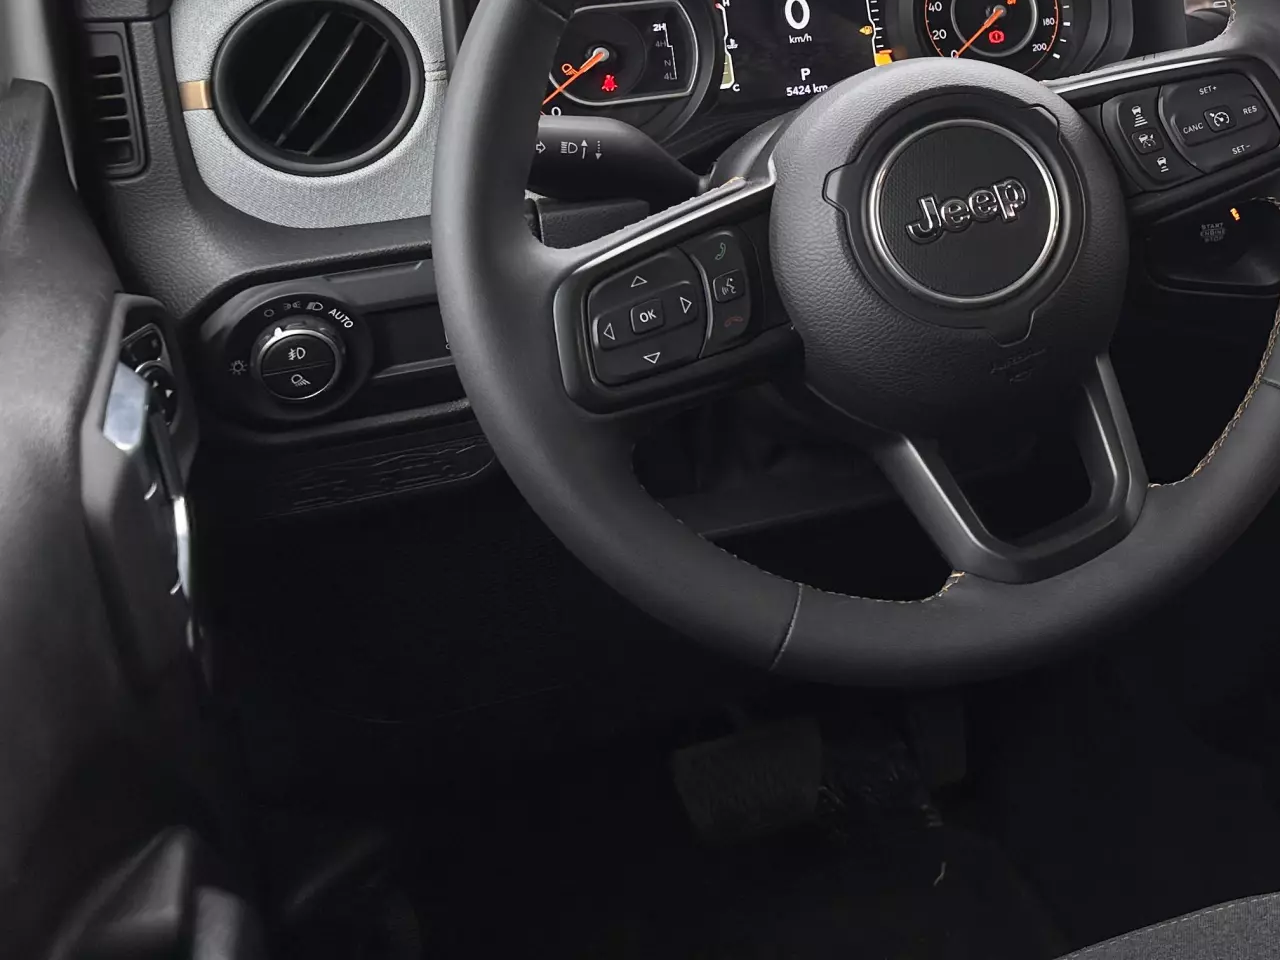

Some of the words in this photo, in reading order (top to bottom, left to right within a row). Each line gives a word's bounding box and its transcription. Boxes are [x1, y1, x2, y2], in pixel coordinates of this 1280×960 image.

[722, 0, 731, 7] H
[928, 1, 943, 12] 40
[1042, 17, 1055, 26] 180
[653, 23, 666, 32] 2H
[789, 33, 813, 44] km/h
[932, 29, 947, 40] 20
[1032, 42, 1047, 52] 200
[800, 68, 811, 81] P
[732, 84, 740, 92] C
[786, 84, 812, 97] 5424
[813, 83, 828, 93] km
[1199, 85, 1217, 96] SET+
[551, 106, 561, 116] 0
[1242, 105, 1258, 115] RES
[1183, 122, 1204, 134] CANC
[906, 179, 1026, 241] Jeep
[327, 308, 354, 329] AUTO
[640, 309, 657, 323] OK
